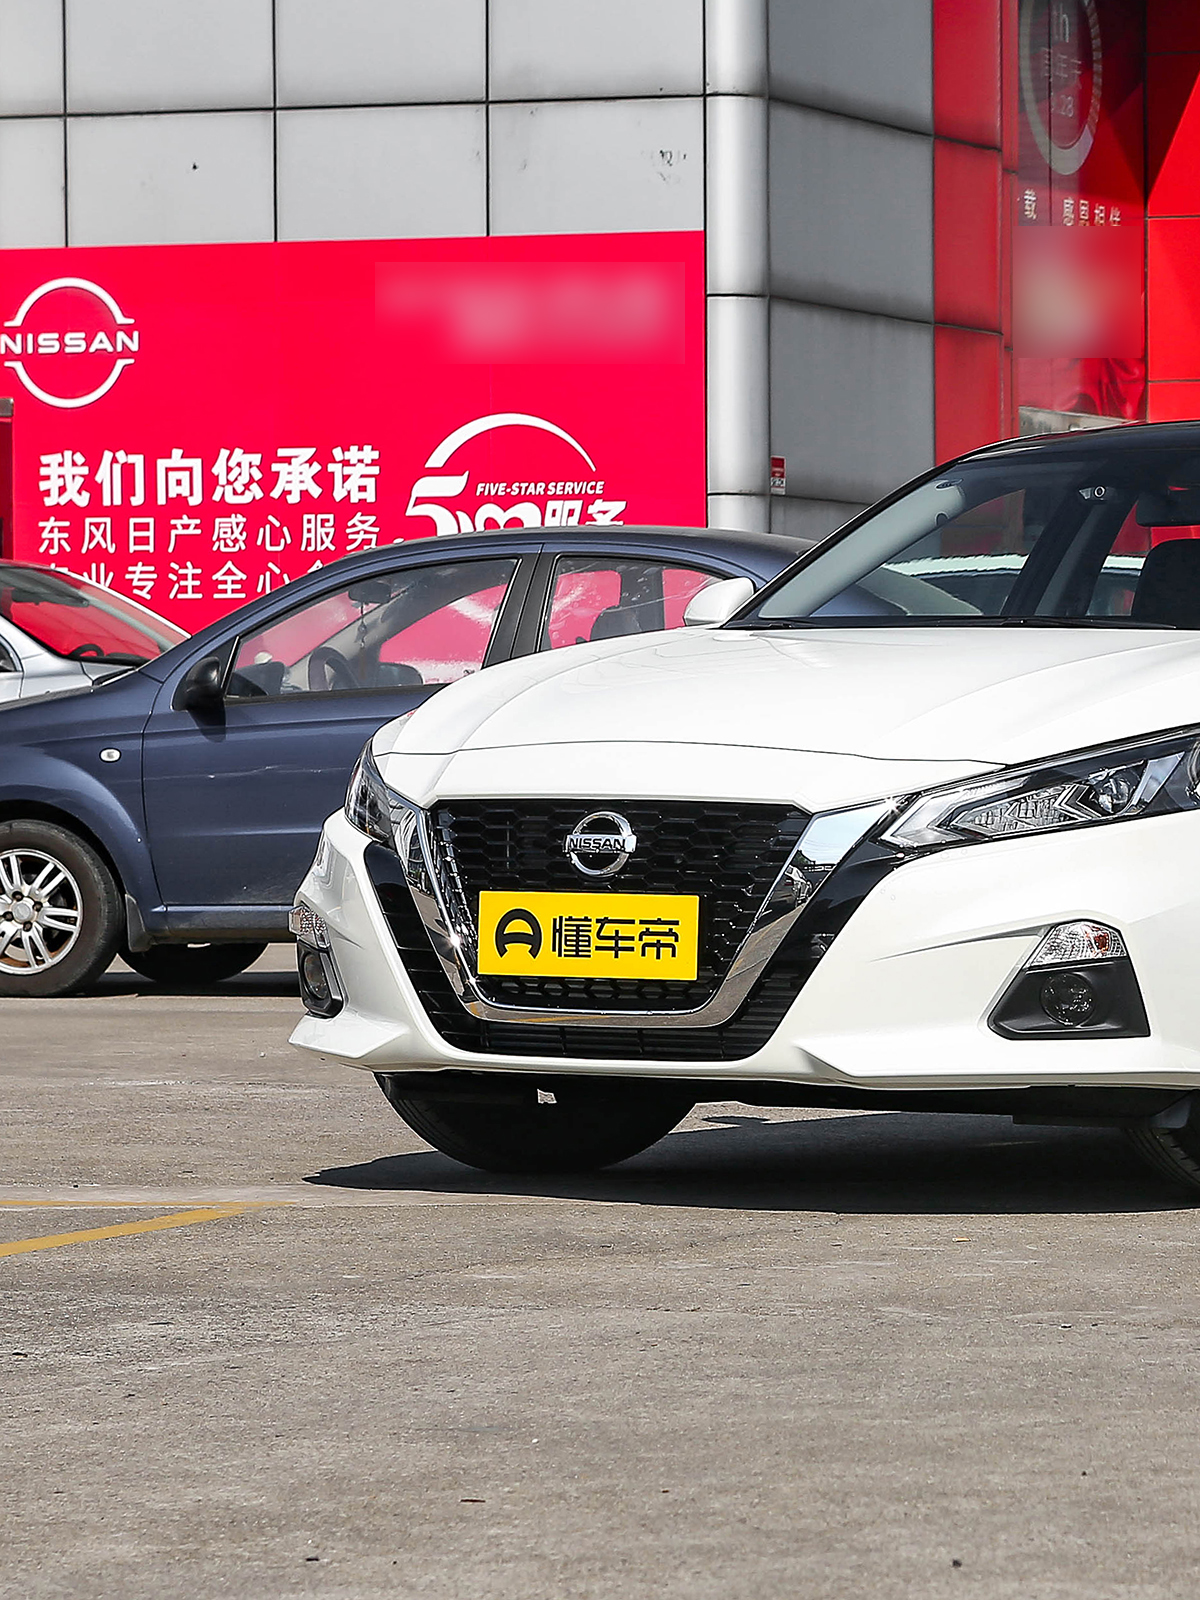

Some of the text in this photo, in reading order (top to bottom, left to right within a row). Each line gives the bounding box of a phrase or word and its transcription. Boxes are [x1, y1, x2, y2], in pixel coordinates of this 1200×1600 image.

[0, 330, 139, 355] NISSAN
[38, 445, 381, 507] 我们向您承诺
[476, 481, 605, 496] FIVE-STAR SERVICE
[37, 511, 381, 555] 东风日产感心服务
[50, 560, 324, 600] 业专注全心
[569, 837, 627, 850] NISSAN
[552, 916, 680, 960] 懂车帝
